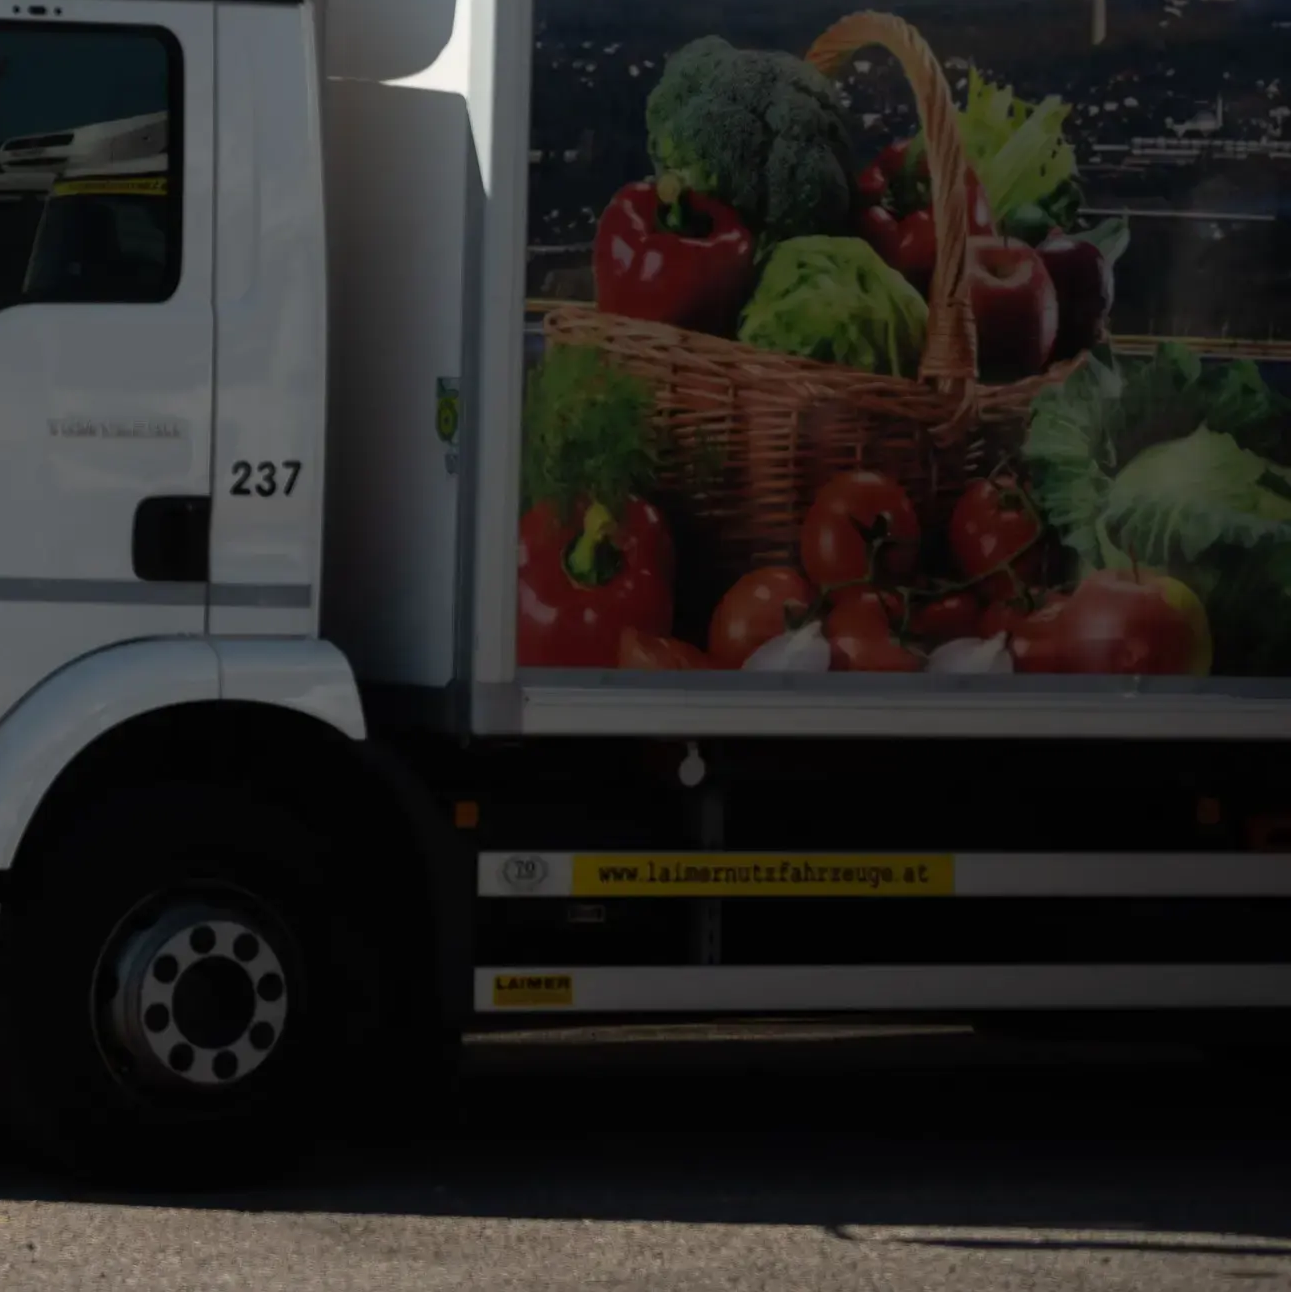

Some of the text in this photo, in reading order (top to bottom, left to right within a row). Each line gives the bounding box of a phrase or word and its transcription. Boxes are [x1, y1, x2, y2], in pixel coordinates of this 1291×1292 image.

[229, 460, 303, 498] 237
[598, 861, 929, 889] www.laimernutzfahrzeuge.at
[495, 976, 570, 990] LAIMER
